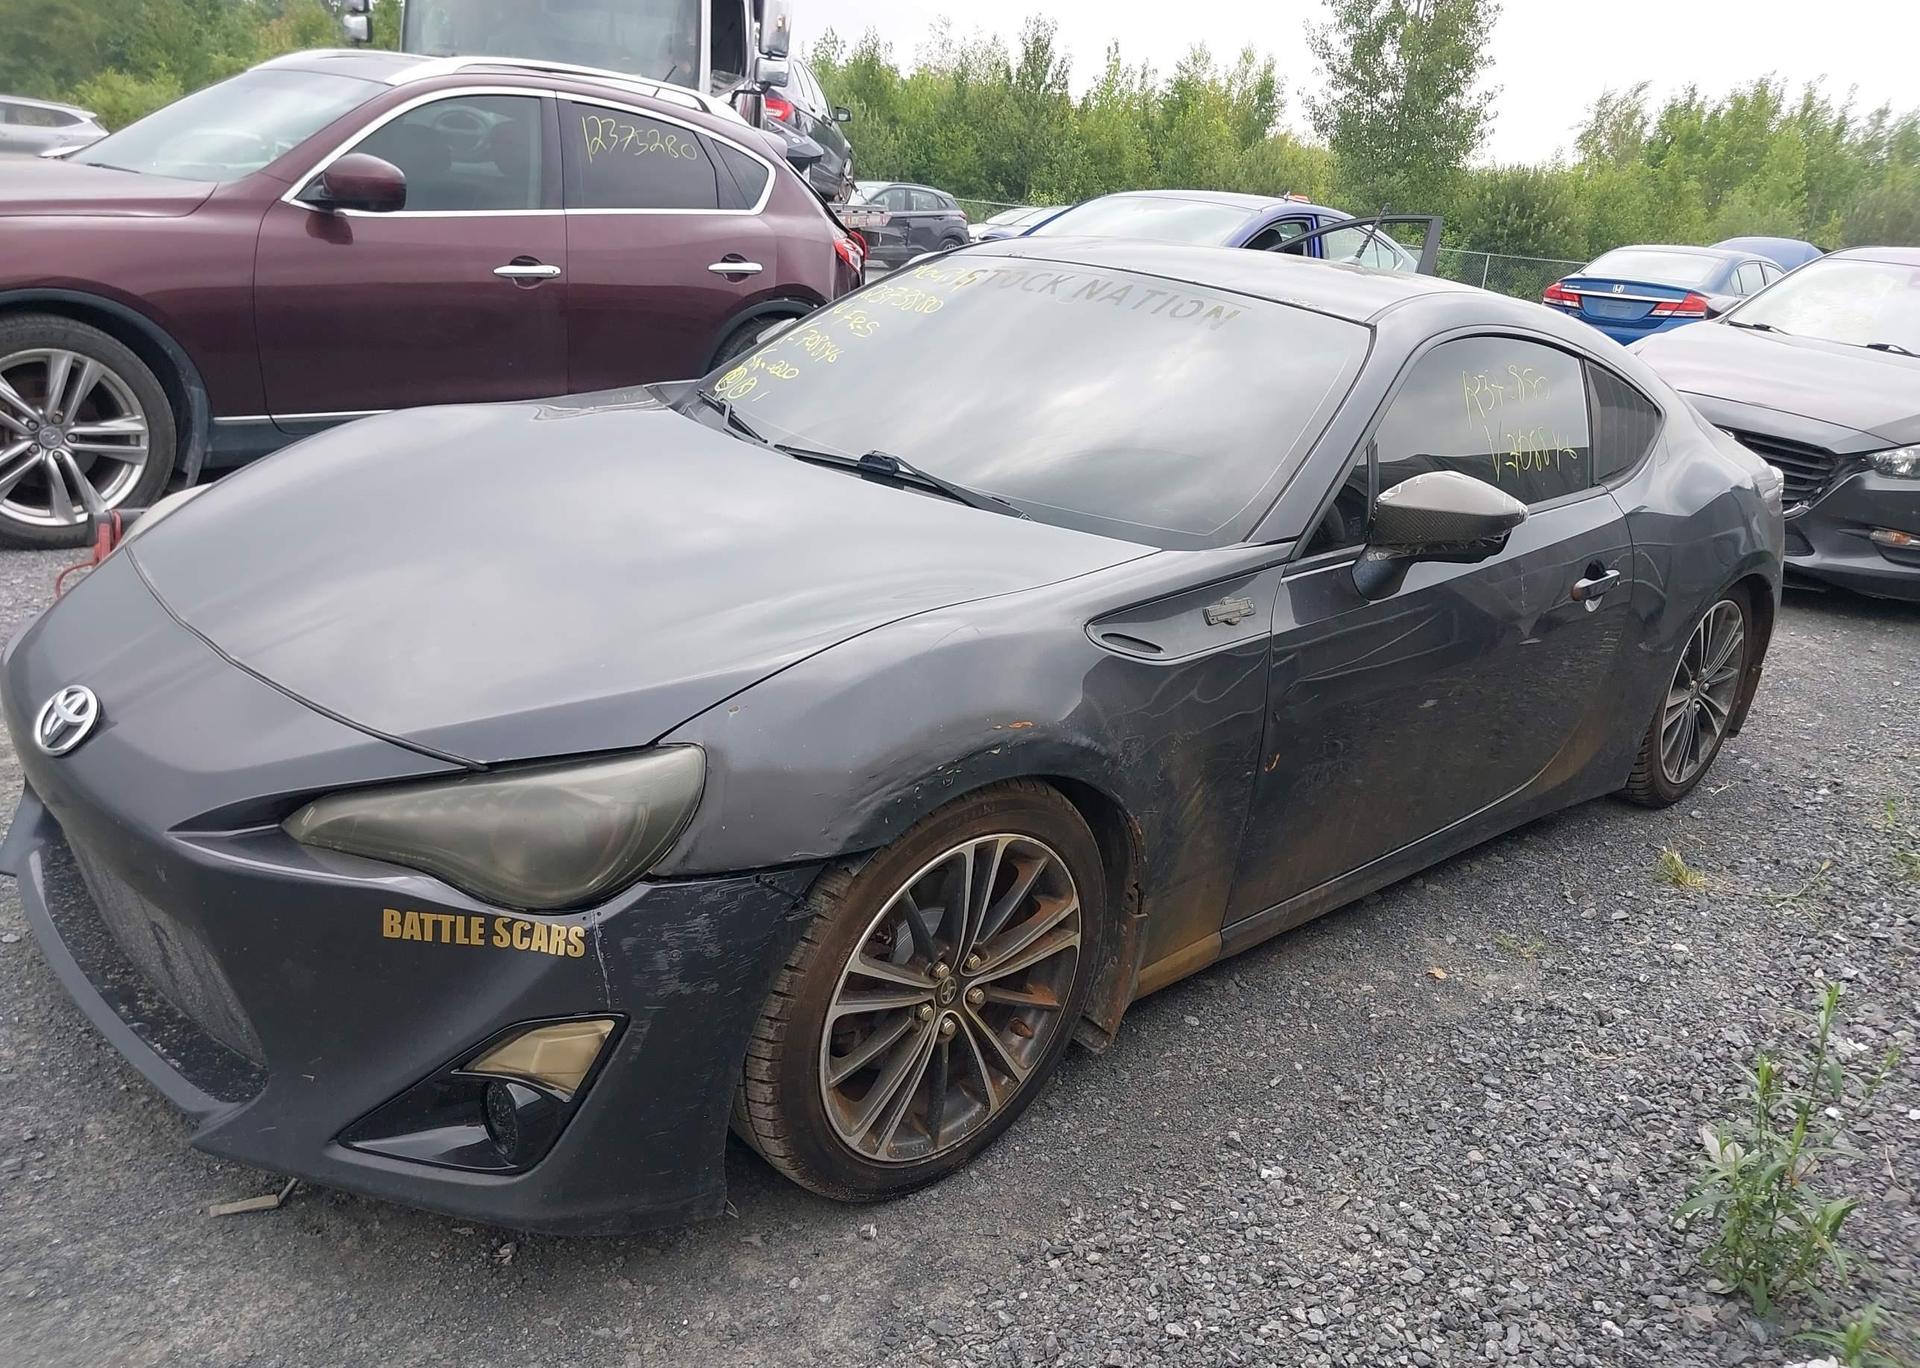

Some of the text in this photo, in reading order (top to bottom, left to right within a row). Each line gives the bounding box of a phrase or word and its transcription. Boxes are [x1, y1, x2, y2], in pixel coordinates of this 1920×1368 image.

[581, 115, 698, 164] 12375280
[1072, 279, 1241, 331] NATION
[383, 908, 586, 958] BATTLE SCARS
